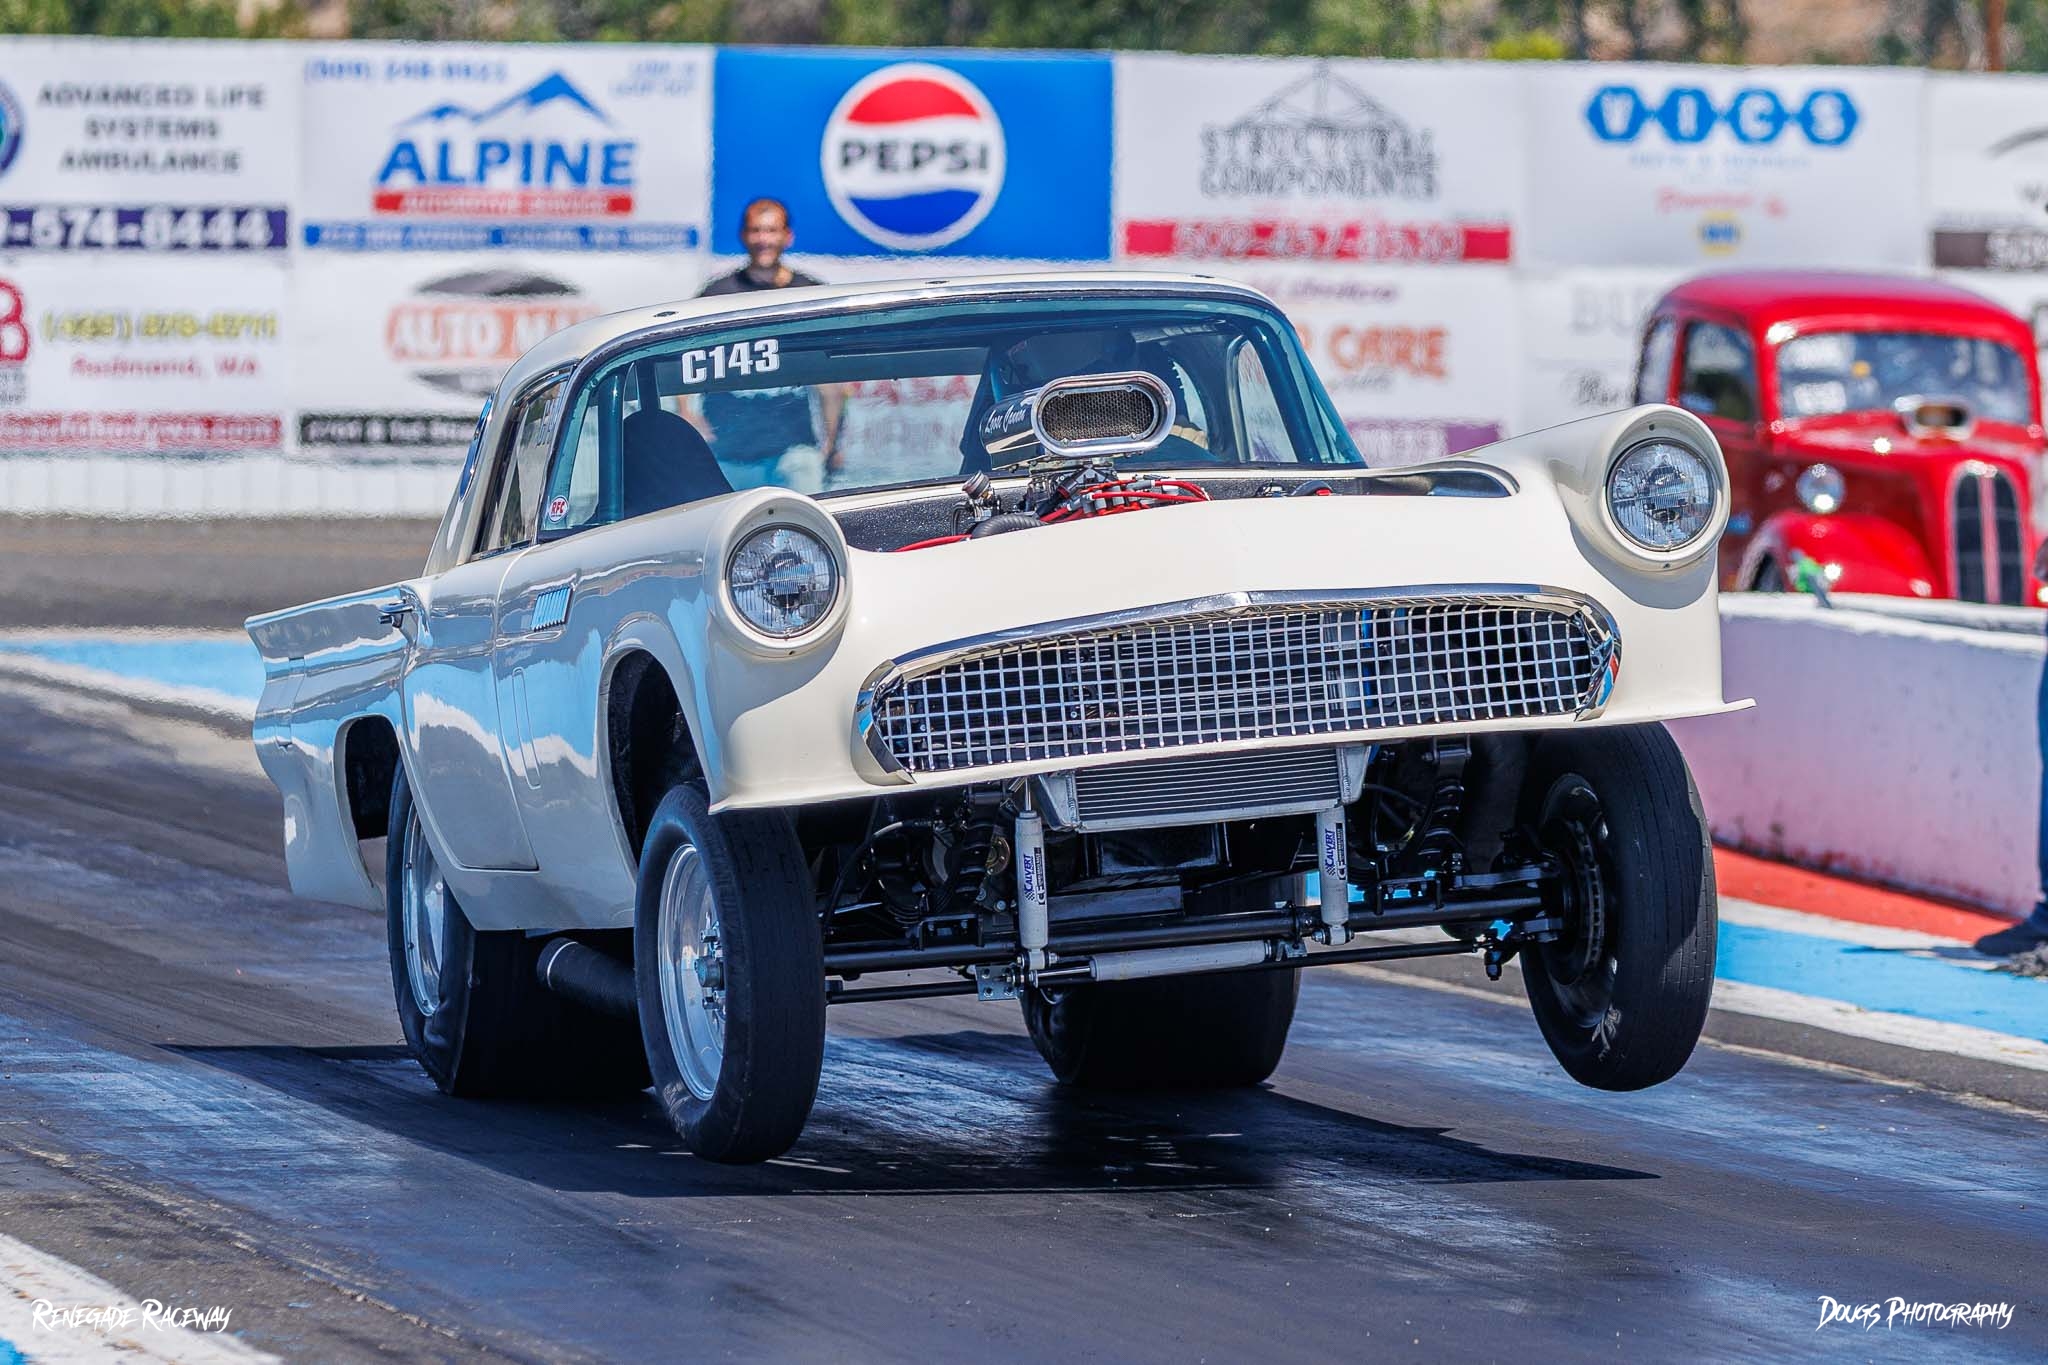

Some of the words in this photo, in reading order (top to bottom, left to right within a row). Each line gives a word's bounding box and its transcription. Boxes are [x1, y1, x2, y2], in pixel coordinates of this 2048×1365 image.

[38, 82, 195, 108] ADVANCED
[205, 83, 266, 108] LIFE
[84, 116, 220, 140] SYSTEMS
[1588, 86, 1857, 145] VICS
[60, 150, 241, 173] AMBULANCE
[375, 139, 636, 185] ALPINE
[839, 138, 989, 171] PEPSI
[394, 307, 500, 352] AUTO
[682, 339, 780, 384] C143
[1024, 853, 1033, 892] CALVERT
